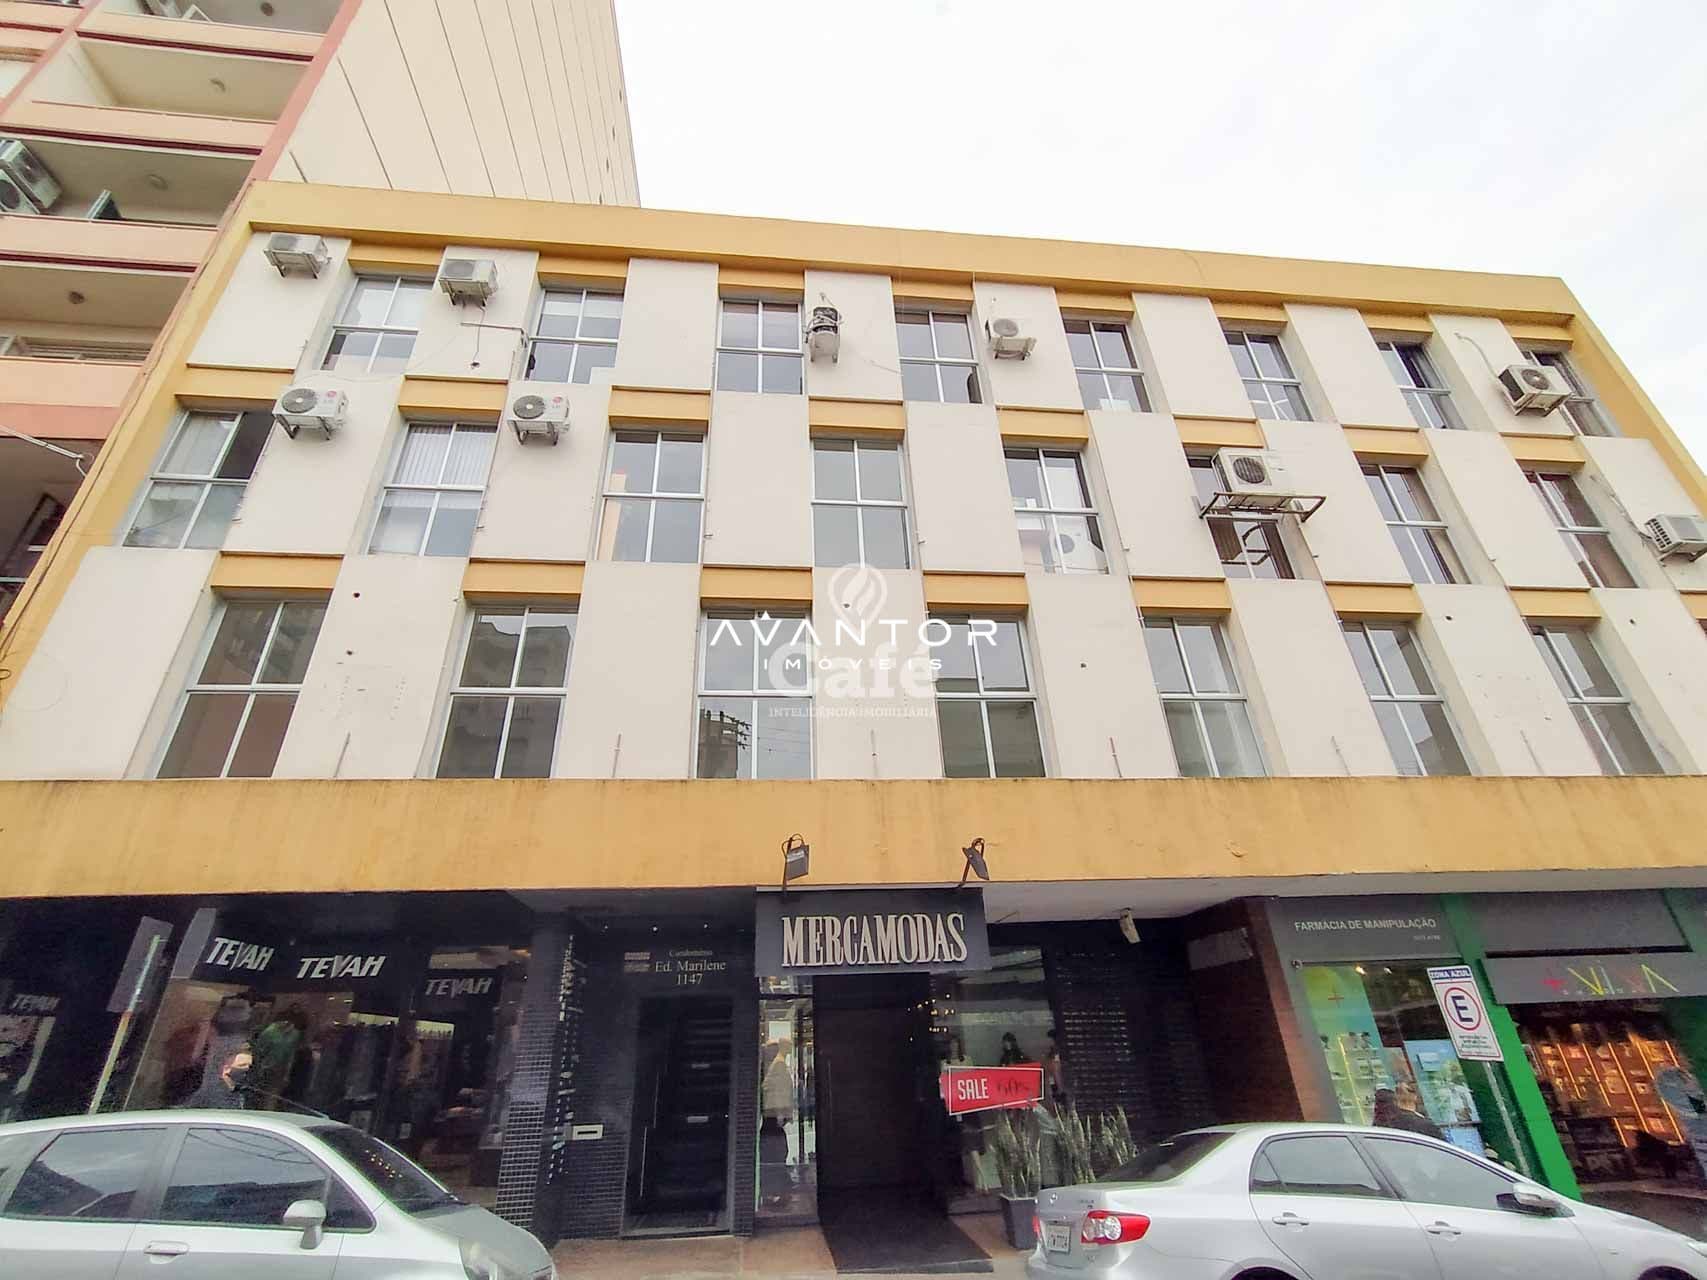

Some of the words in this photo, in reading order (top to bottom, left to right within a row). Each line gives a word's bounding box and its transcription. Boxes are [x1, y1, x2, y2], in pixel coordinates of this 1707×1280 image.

[1348, 919, 1363, 930] DE
[1364, 916, 1437, 930] MANIPULAÇÃO
[781, 913, 968, 967] MERCAMODAS
[205, 937, 275, 971] TEVAH
[296, 954, 386, 979] TEVAH
[425, 977, 494, 999] TEVAH
[676, 973, 704, 985] 1147
[1451, 995, 1474, 1022] E
[957, 1077, 990, 1101] SALE
